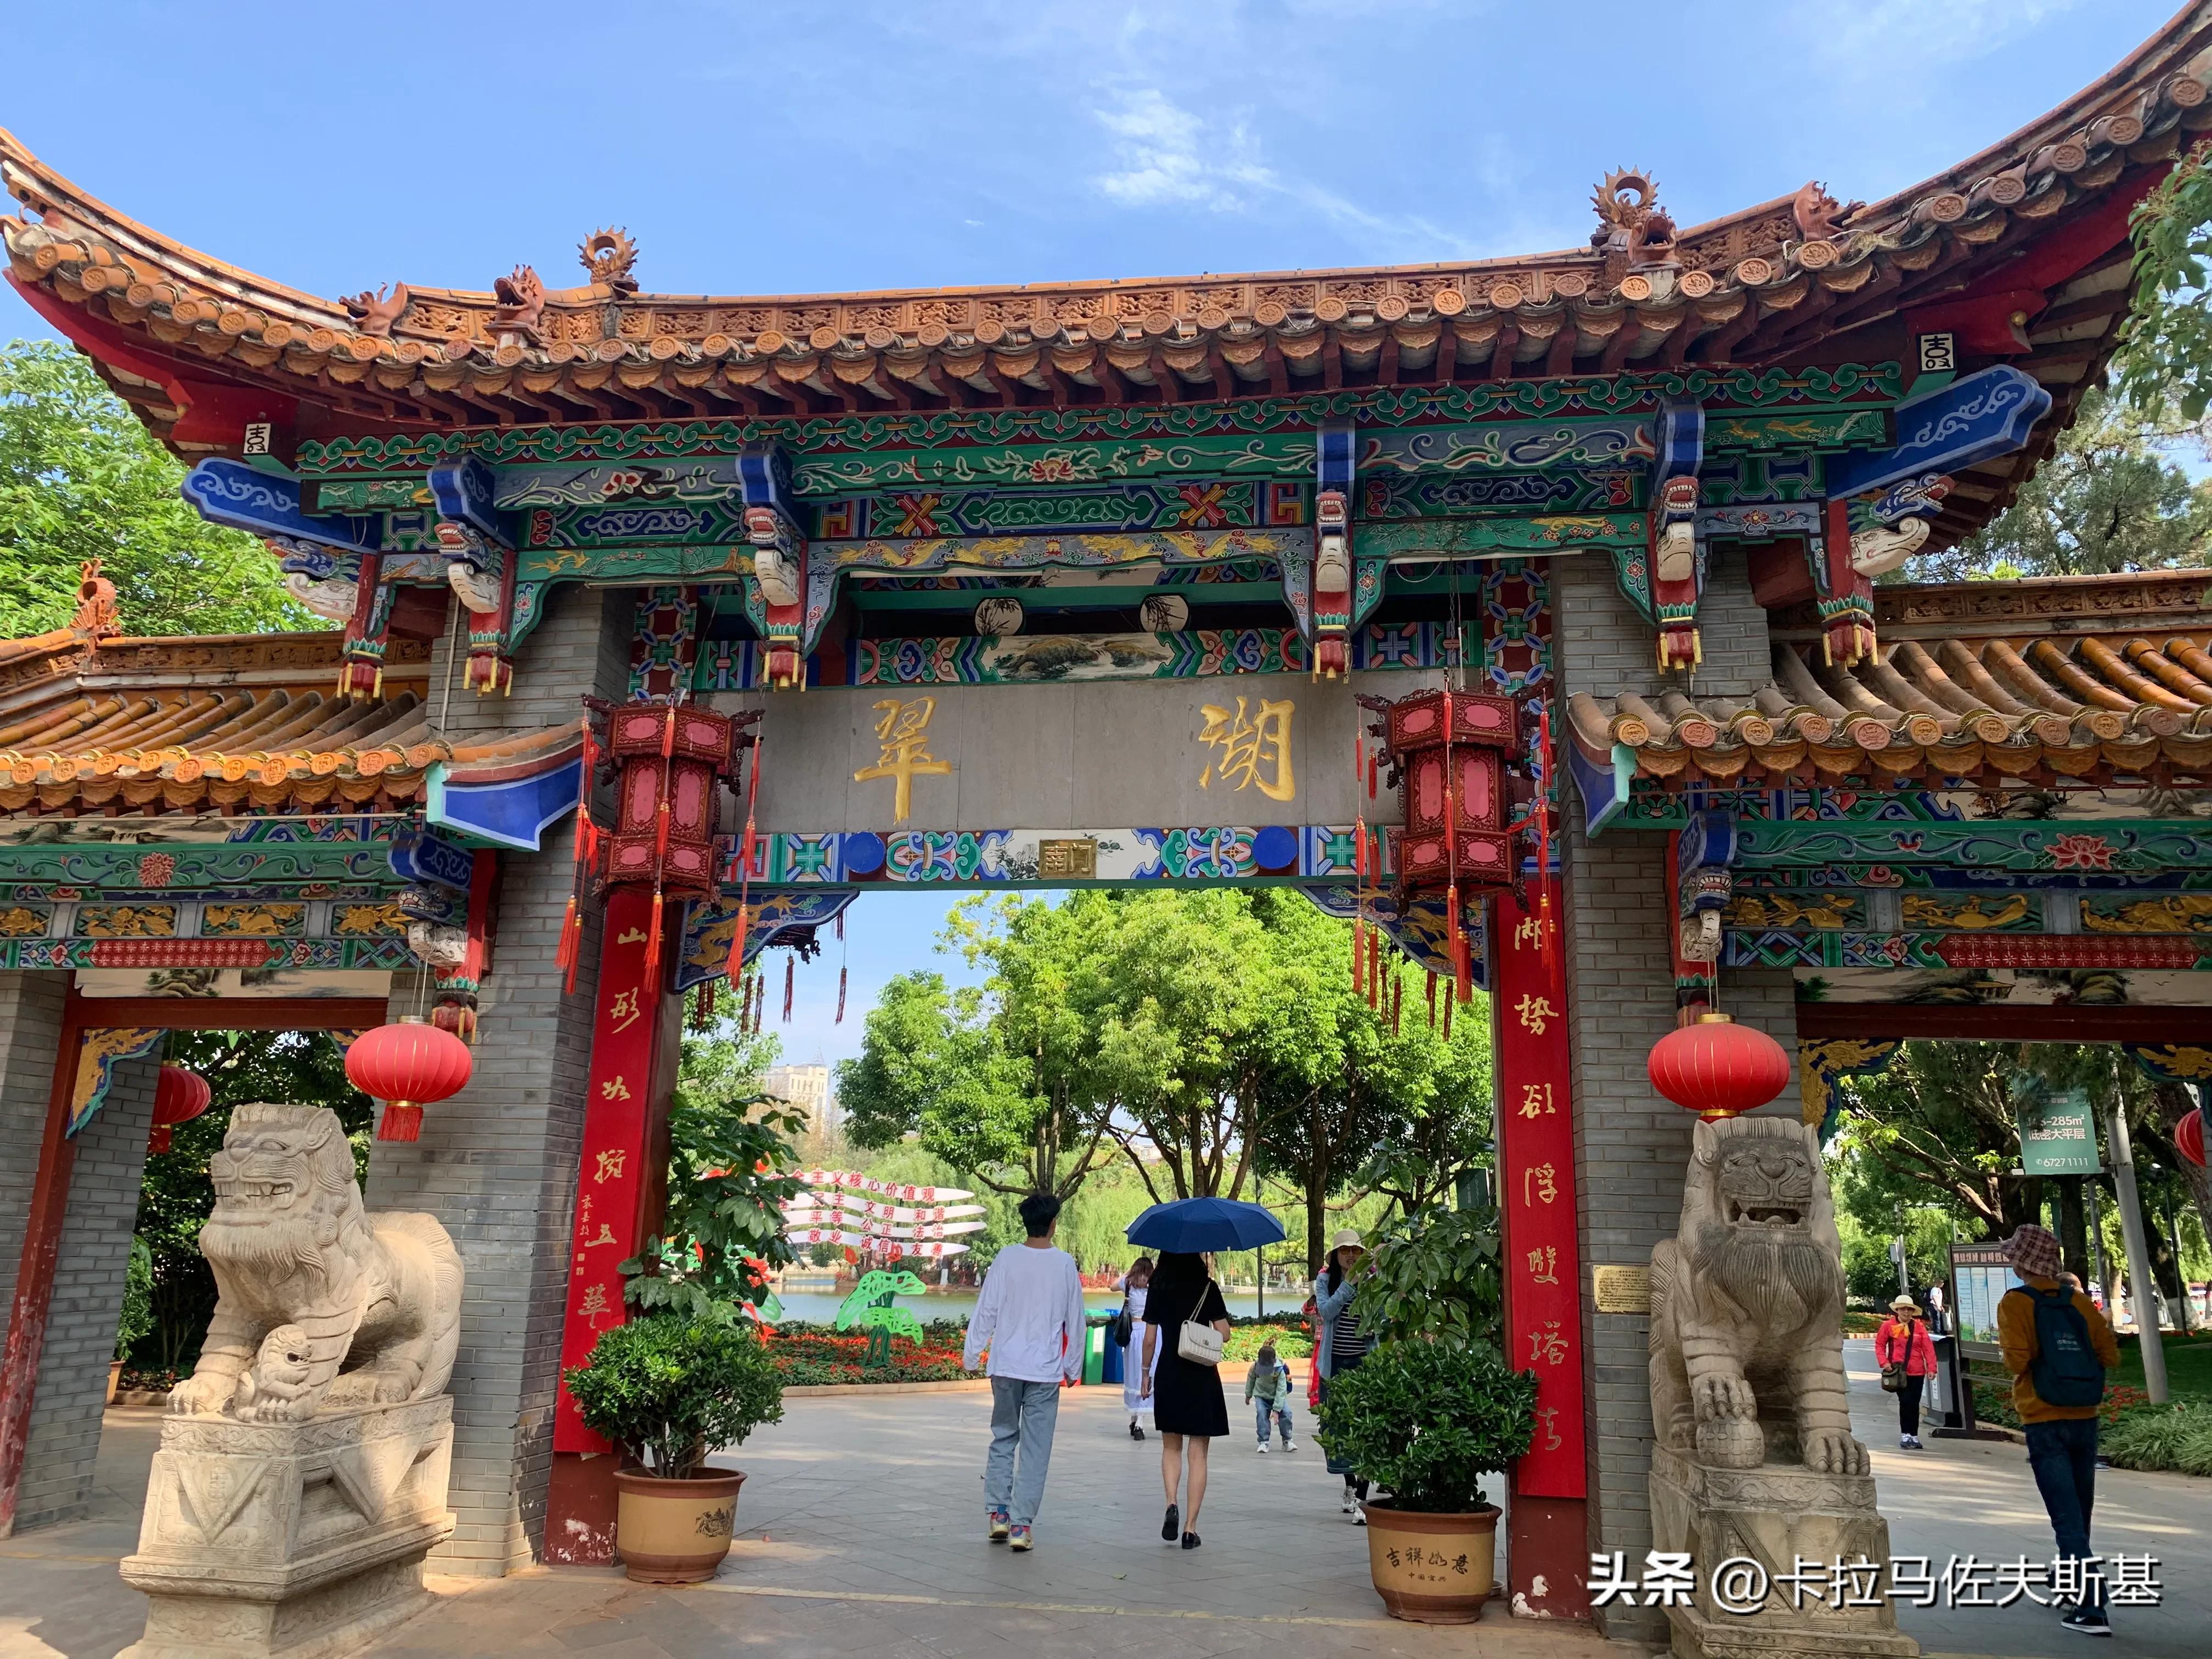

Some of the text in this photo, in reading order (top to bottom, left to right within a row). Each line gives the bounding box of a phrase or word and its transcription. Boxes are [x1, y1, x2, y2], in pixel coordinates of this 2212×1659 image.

[1044, 843, 1091, 874] 南门
[2028, 1128, 2086, 1141] 低密大平层
[810, 1209, 944, 1239] 平等 公正 法治
[864, 1199, 895, 1220] 文明
[915, 1206, 945, 1222] 和谐
[808, 1228, 944, 1257] 敬业 诚信 友善
[1386, 1547, 1469, 1575] 吉祥如意
